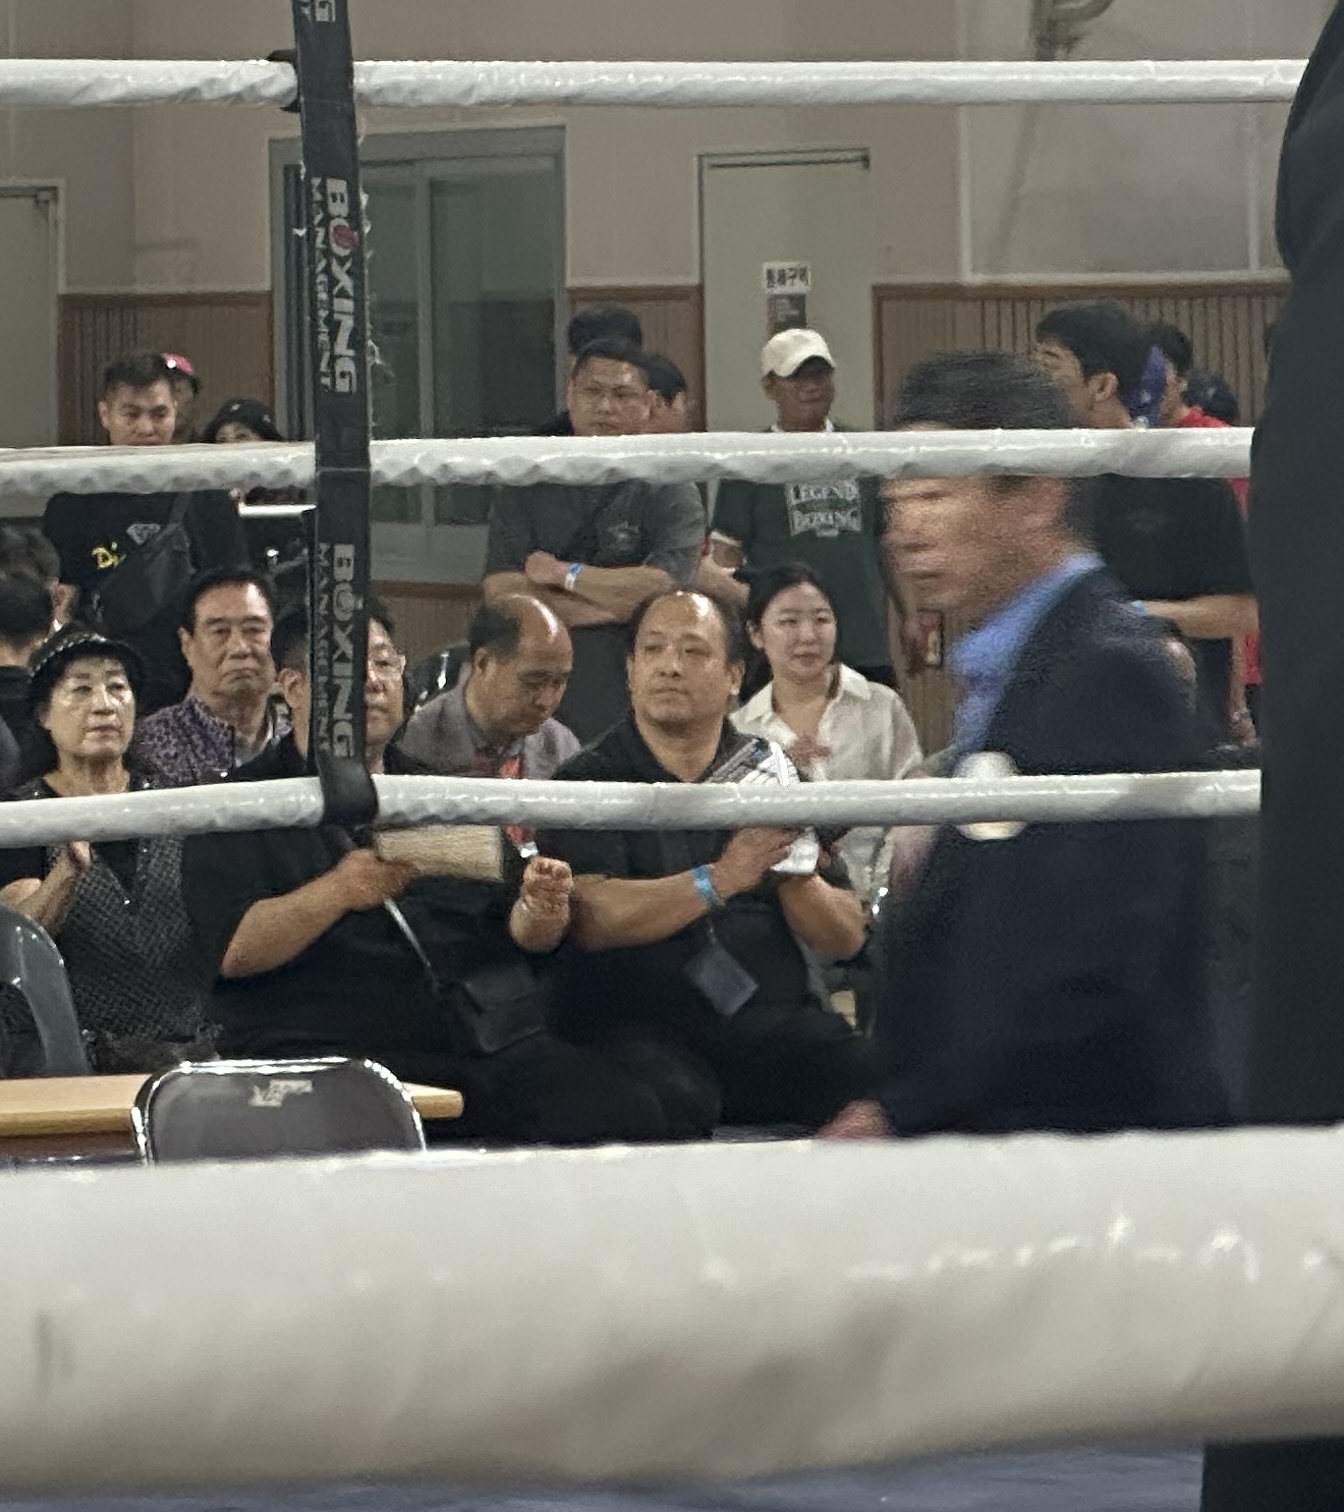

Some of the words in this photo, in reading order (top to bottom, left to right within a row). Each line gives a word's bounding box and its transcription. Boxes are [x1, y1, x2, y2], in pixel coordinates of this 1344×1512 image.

[311, 176, 331, 391] MANAGEMENT
[325, 177, 359, 393] BOXING
[332, 543, 364, 758] BOXING
